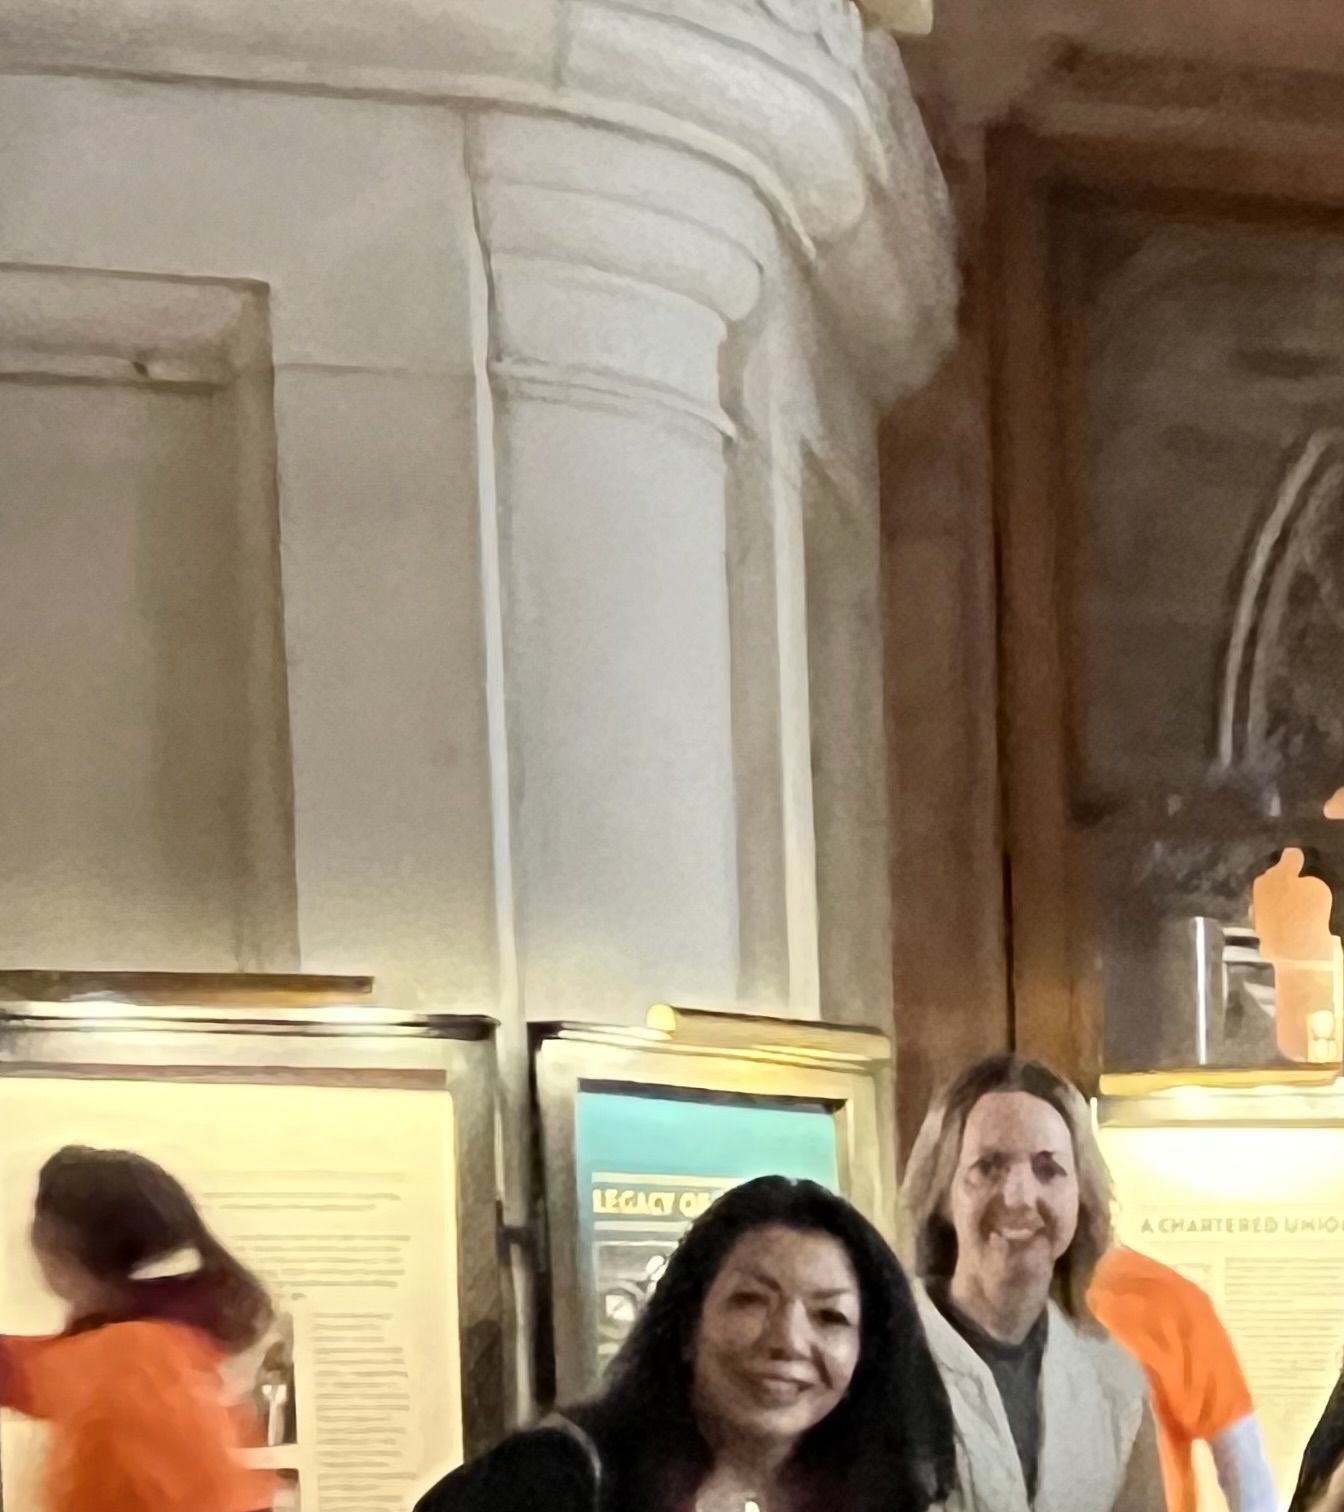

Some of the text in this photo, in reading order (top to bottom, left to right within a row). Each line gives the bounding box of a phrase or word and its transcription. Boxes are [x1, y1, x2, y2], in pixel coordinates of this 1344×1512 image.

[592, 1188, 676, 1216] LEGACY
[1141, 1217, 1154, 1234] A
[1158, 1216, 1278, 1234] CHARTERED
